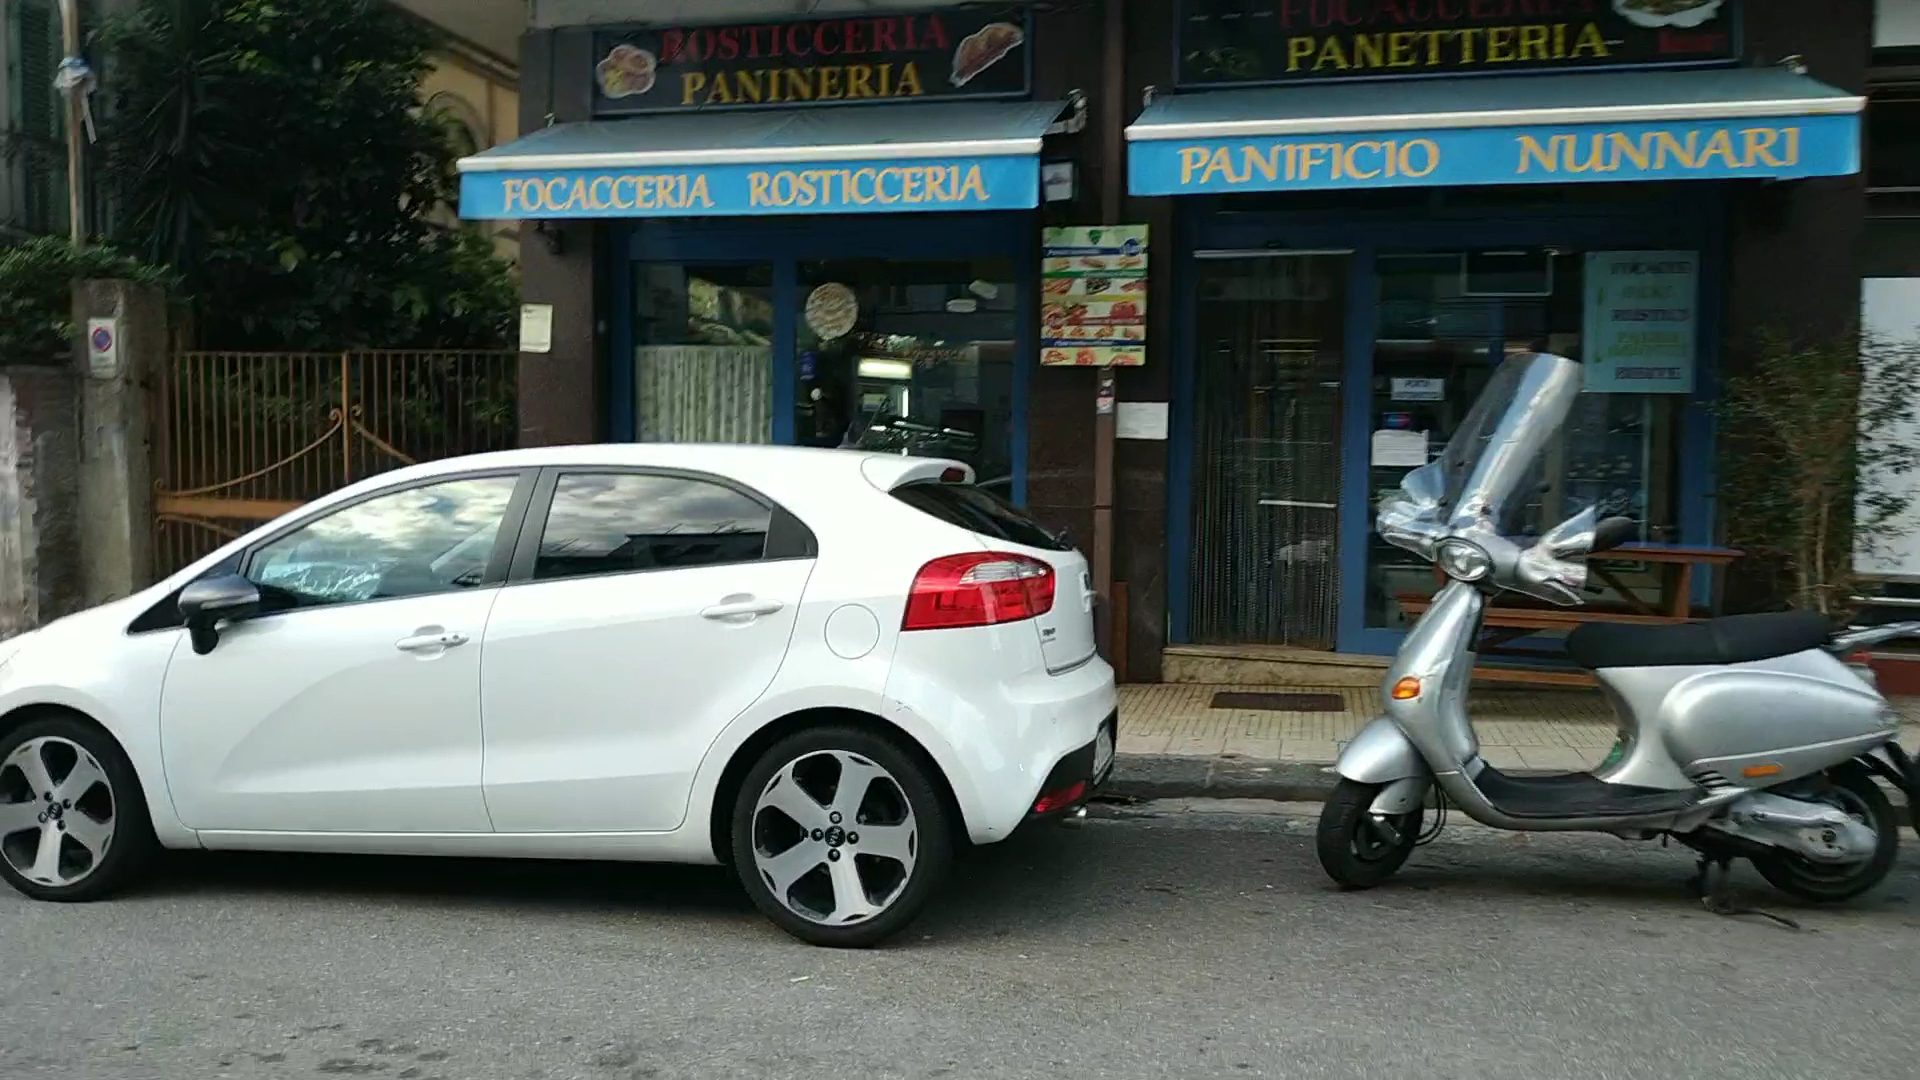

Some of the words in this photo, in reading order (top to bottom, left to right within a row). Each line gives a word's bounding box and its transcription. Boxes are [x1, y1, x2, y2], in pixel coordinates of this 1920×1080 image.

[661, 14, 949, 61] ROSTICCERIA
[1284, 21, 1612, 73] PANETTERIA
[681, 60, 924, 105] PANINERIA
[1178, 139, 1440, 185] PANIFICIO
[1516, 127, 1799, 174] NUNNARI
[502, 173, 715, 213] FOCACCERIA
[748, 165, 991, 207] ROSTICCERIA
